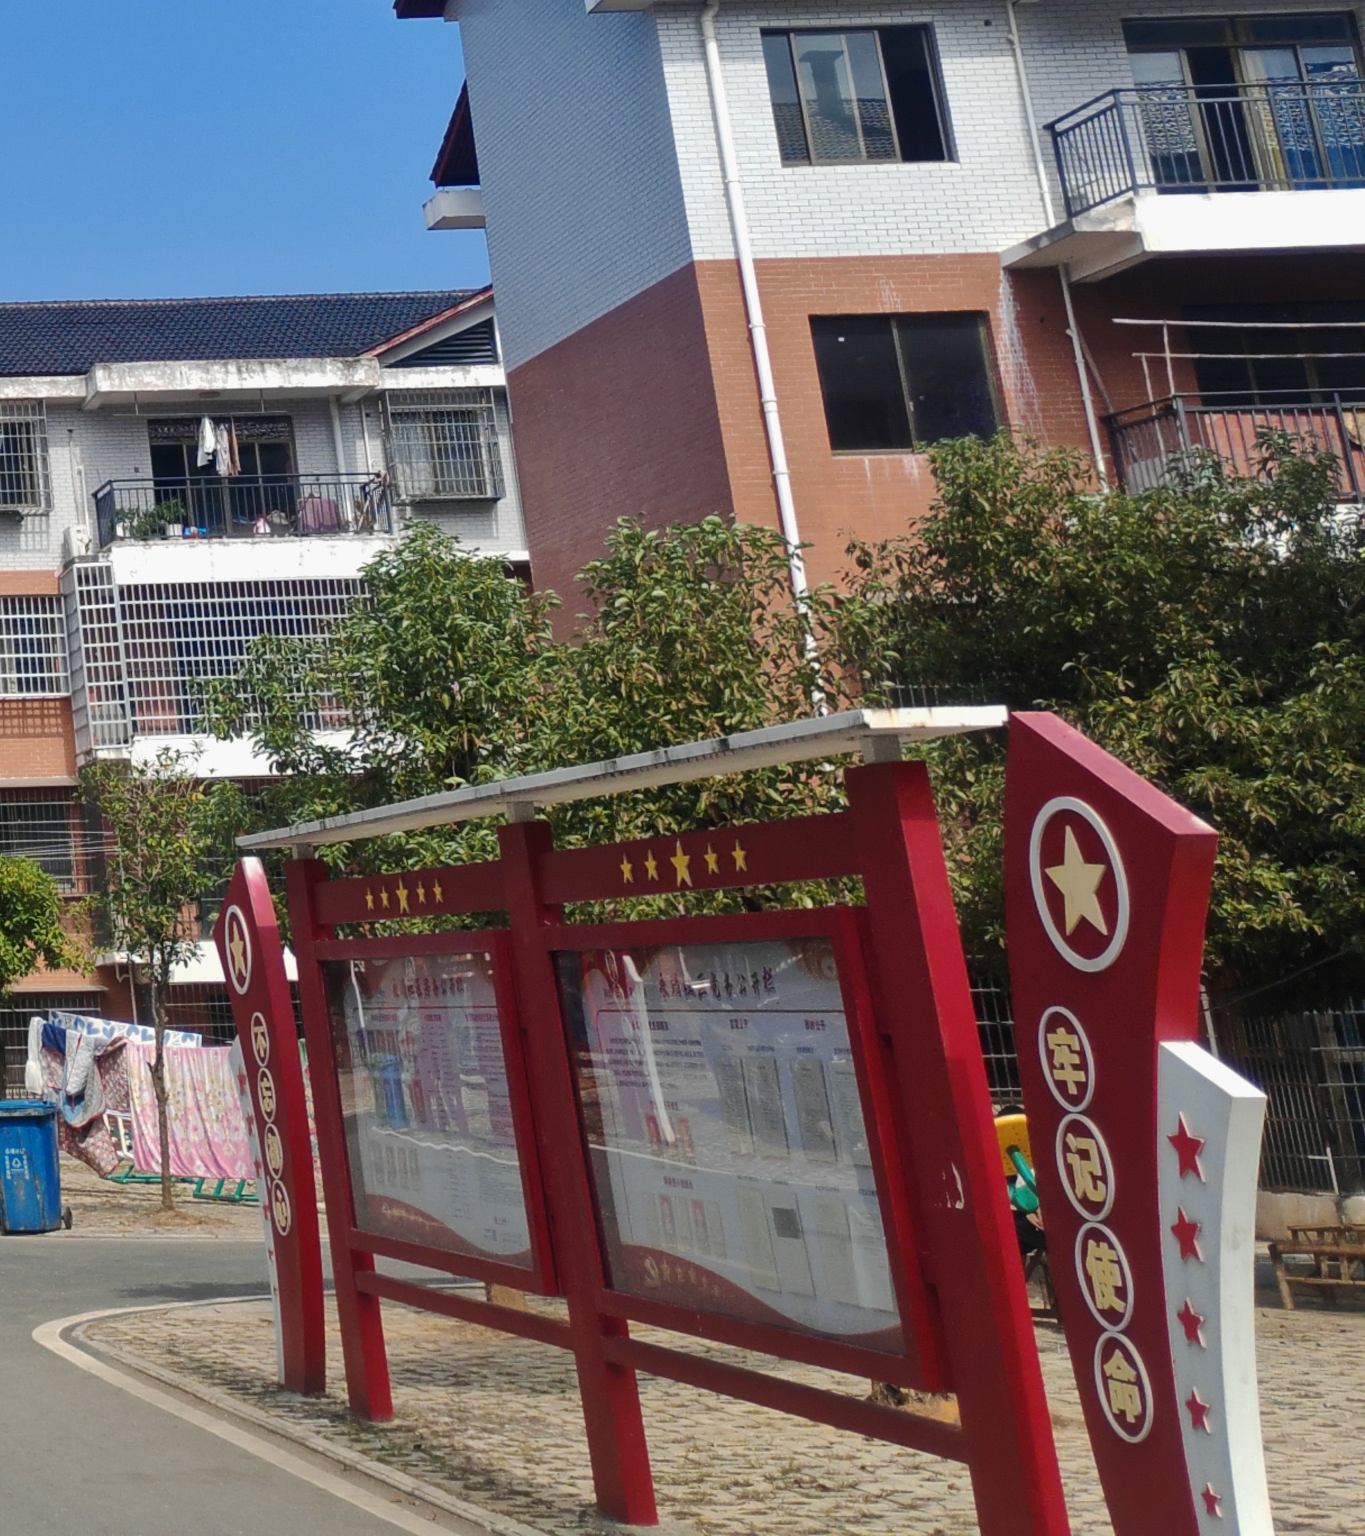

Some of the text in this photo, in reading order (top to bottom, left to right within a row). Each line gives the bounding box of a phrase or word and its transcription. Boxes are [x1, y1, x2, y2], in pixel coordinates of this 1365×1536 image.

[253, 1019, 288, 1229] 不忘初心
[1045, 1027, 1143, 1424] 牢记使命
